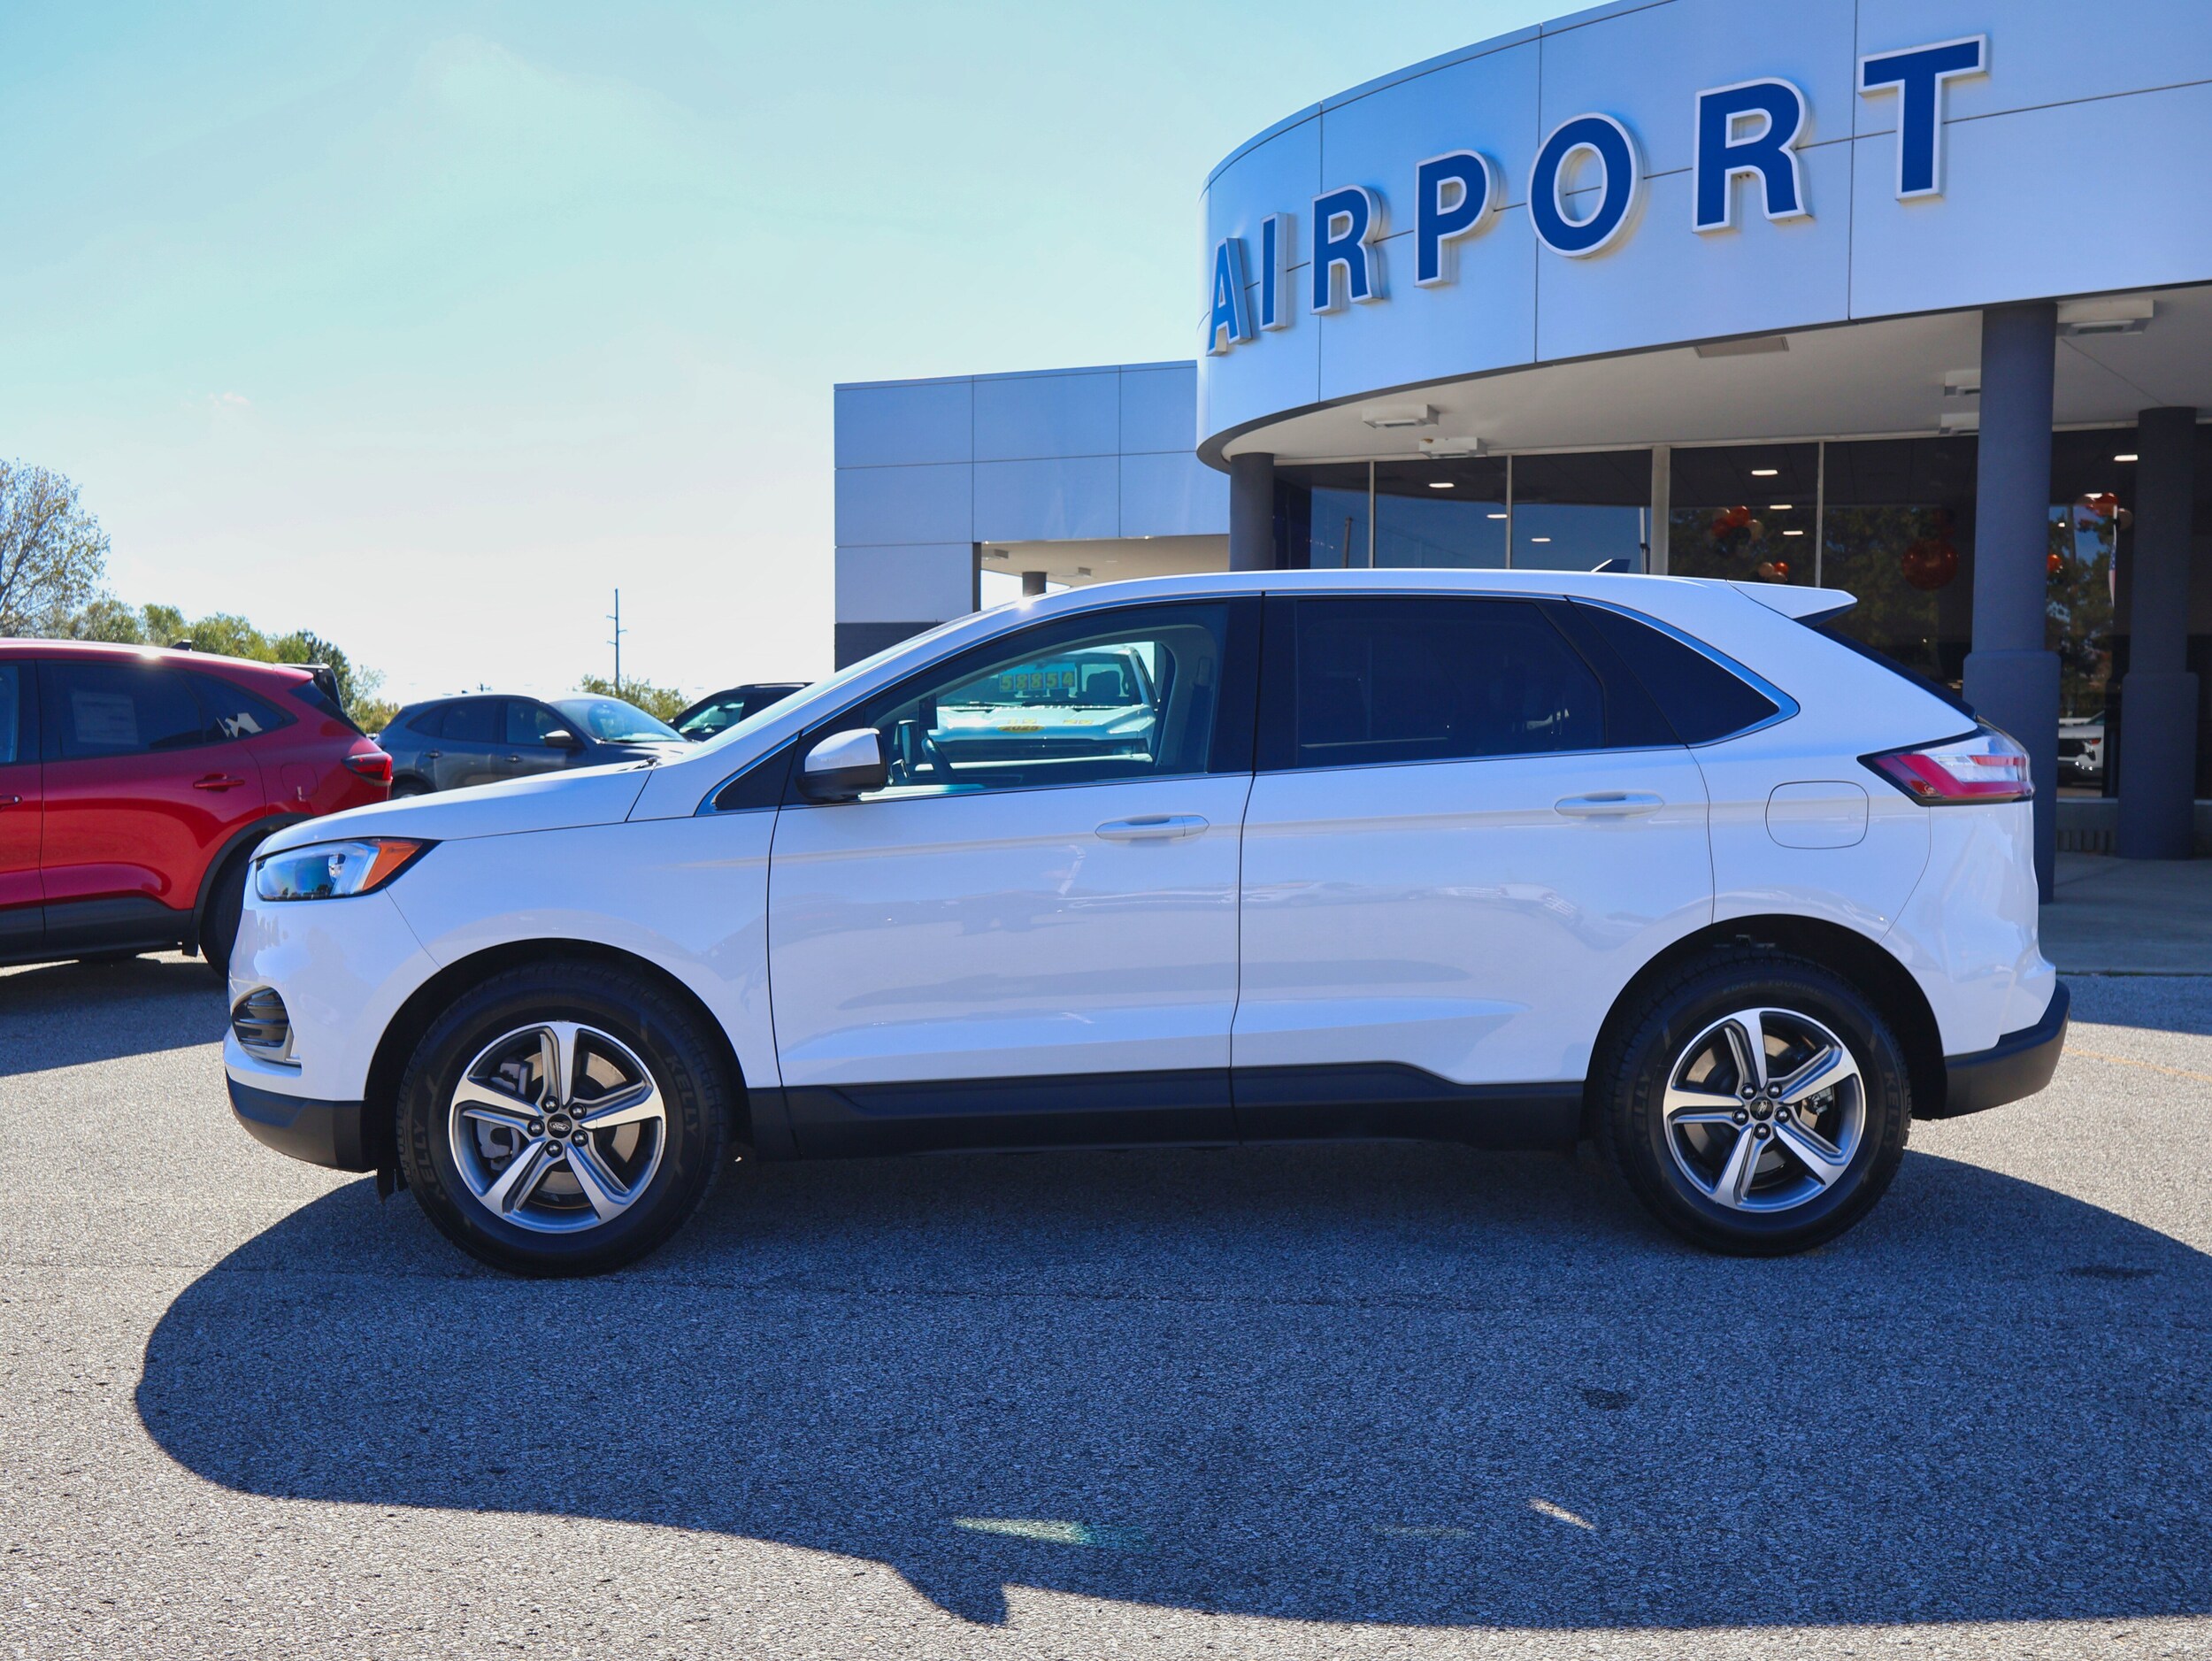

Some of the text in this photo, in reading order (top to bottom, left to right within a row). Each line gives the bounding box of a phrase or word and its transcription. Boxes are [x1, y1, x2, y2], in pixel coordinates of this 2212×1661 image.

[1208, 35, 1987, 357] AIRPORT
[1001, 672, 1075, 691] 58854
[664, 1055, 698, 1137] KELLY
[1884, 1072, 1900, 1150] KELLY
[412, 1118, 447, 1201] KELLY
